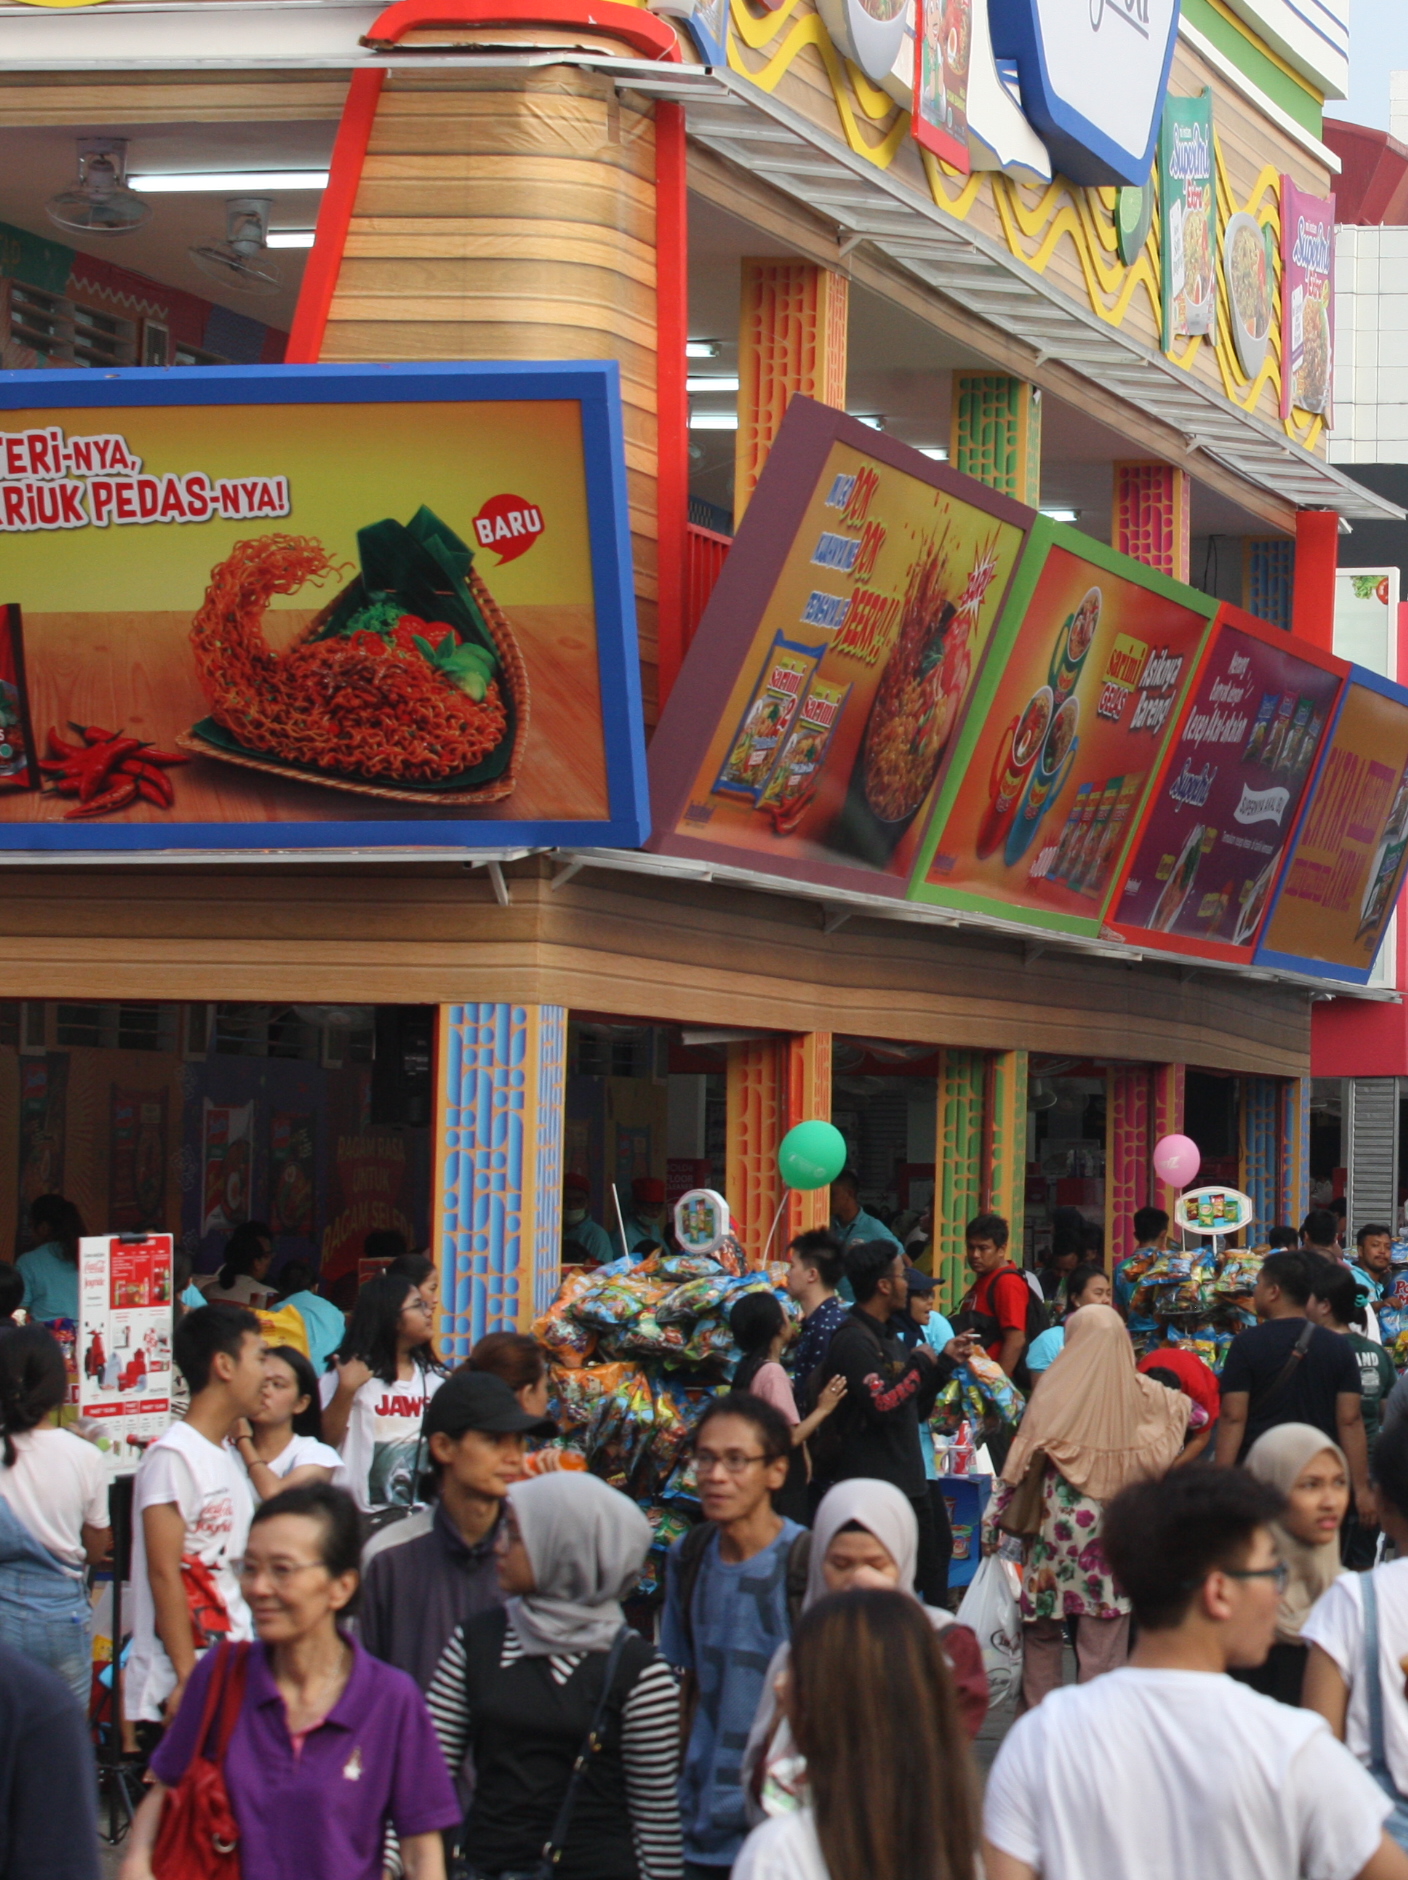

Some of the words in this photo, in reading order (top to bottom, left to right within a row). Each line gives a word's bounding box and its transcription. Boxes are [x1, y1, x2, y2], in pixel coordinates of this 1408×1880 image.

[91, 476, 286, 522] PEDAS-NYA!
[475, 508, 542, 545] BARU
[1107, 645, 1147, 686] sarimi
[1138, 648, 1183, 692] Asiknya
[1130, 689, 1176, 735] Bareng!
